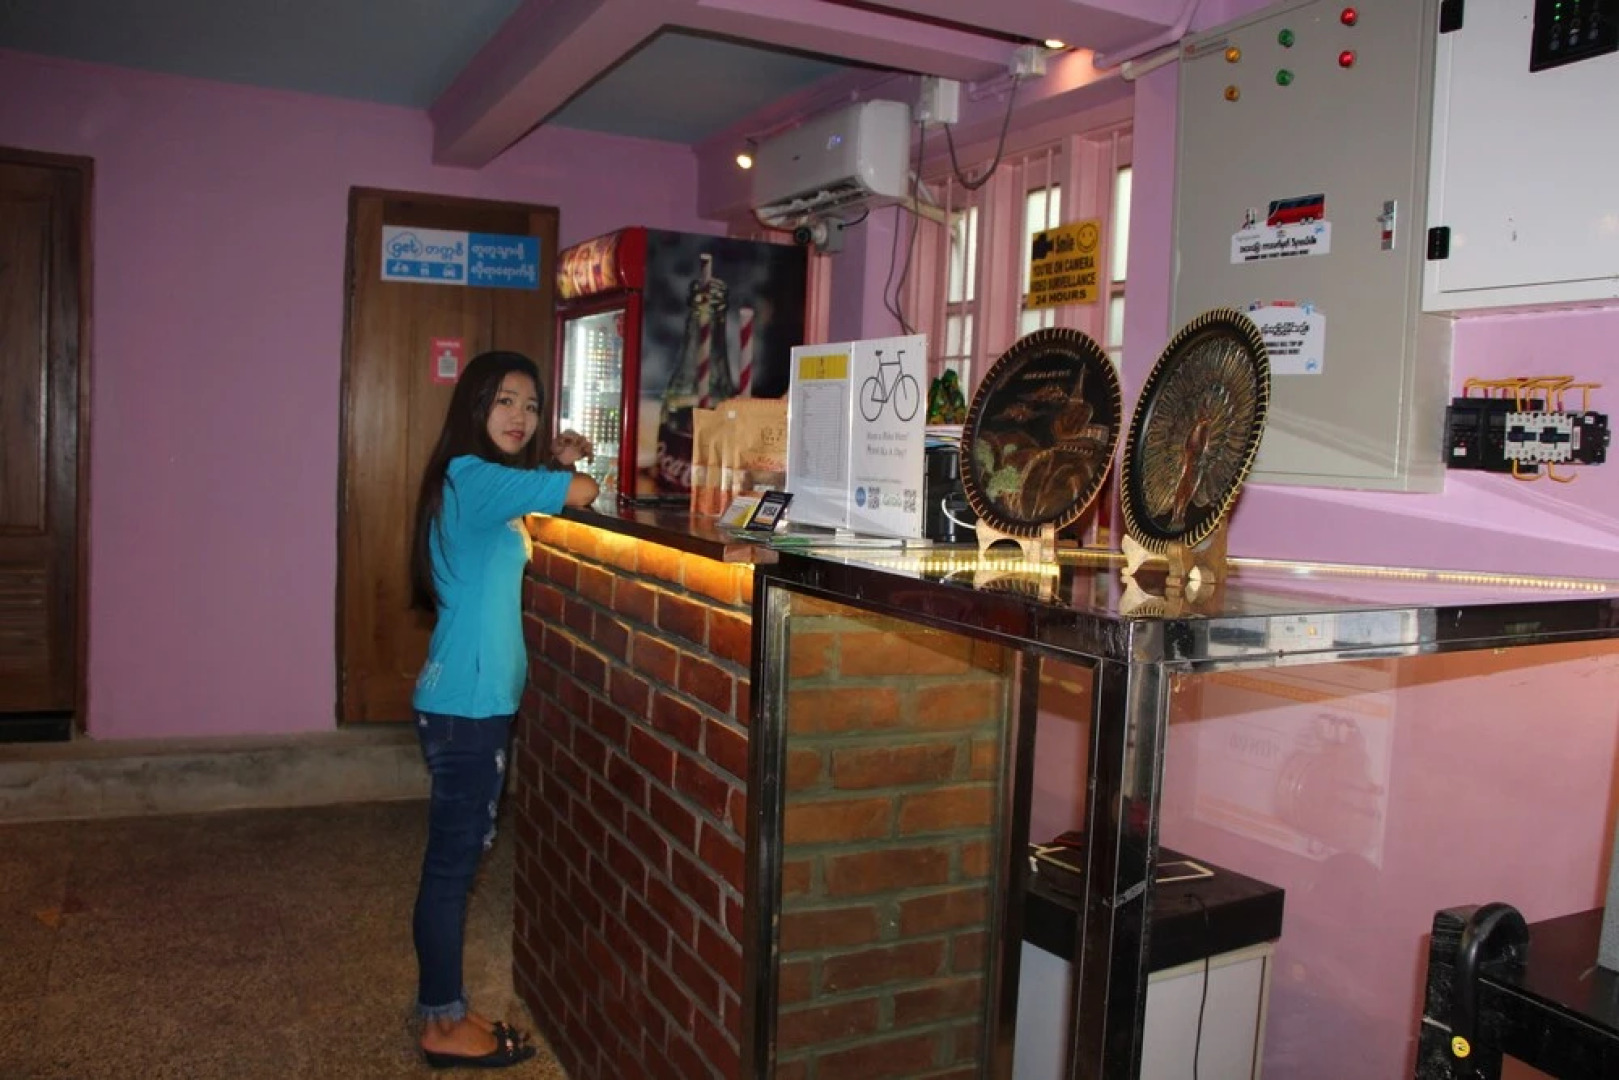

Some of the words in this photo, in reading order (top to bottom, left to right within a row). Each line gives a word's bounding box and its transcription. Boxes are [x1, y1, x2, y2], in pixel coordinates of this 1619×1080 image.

[392, 239, 419, 258] get
[1065, 255, 1094, 272] CAMERA
[1048, 272, 1096, 291] SURVEILLANCE
[1035, 293, 1047, 305] 24
[1049, 289, 1087, 302] HOURS
